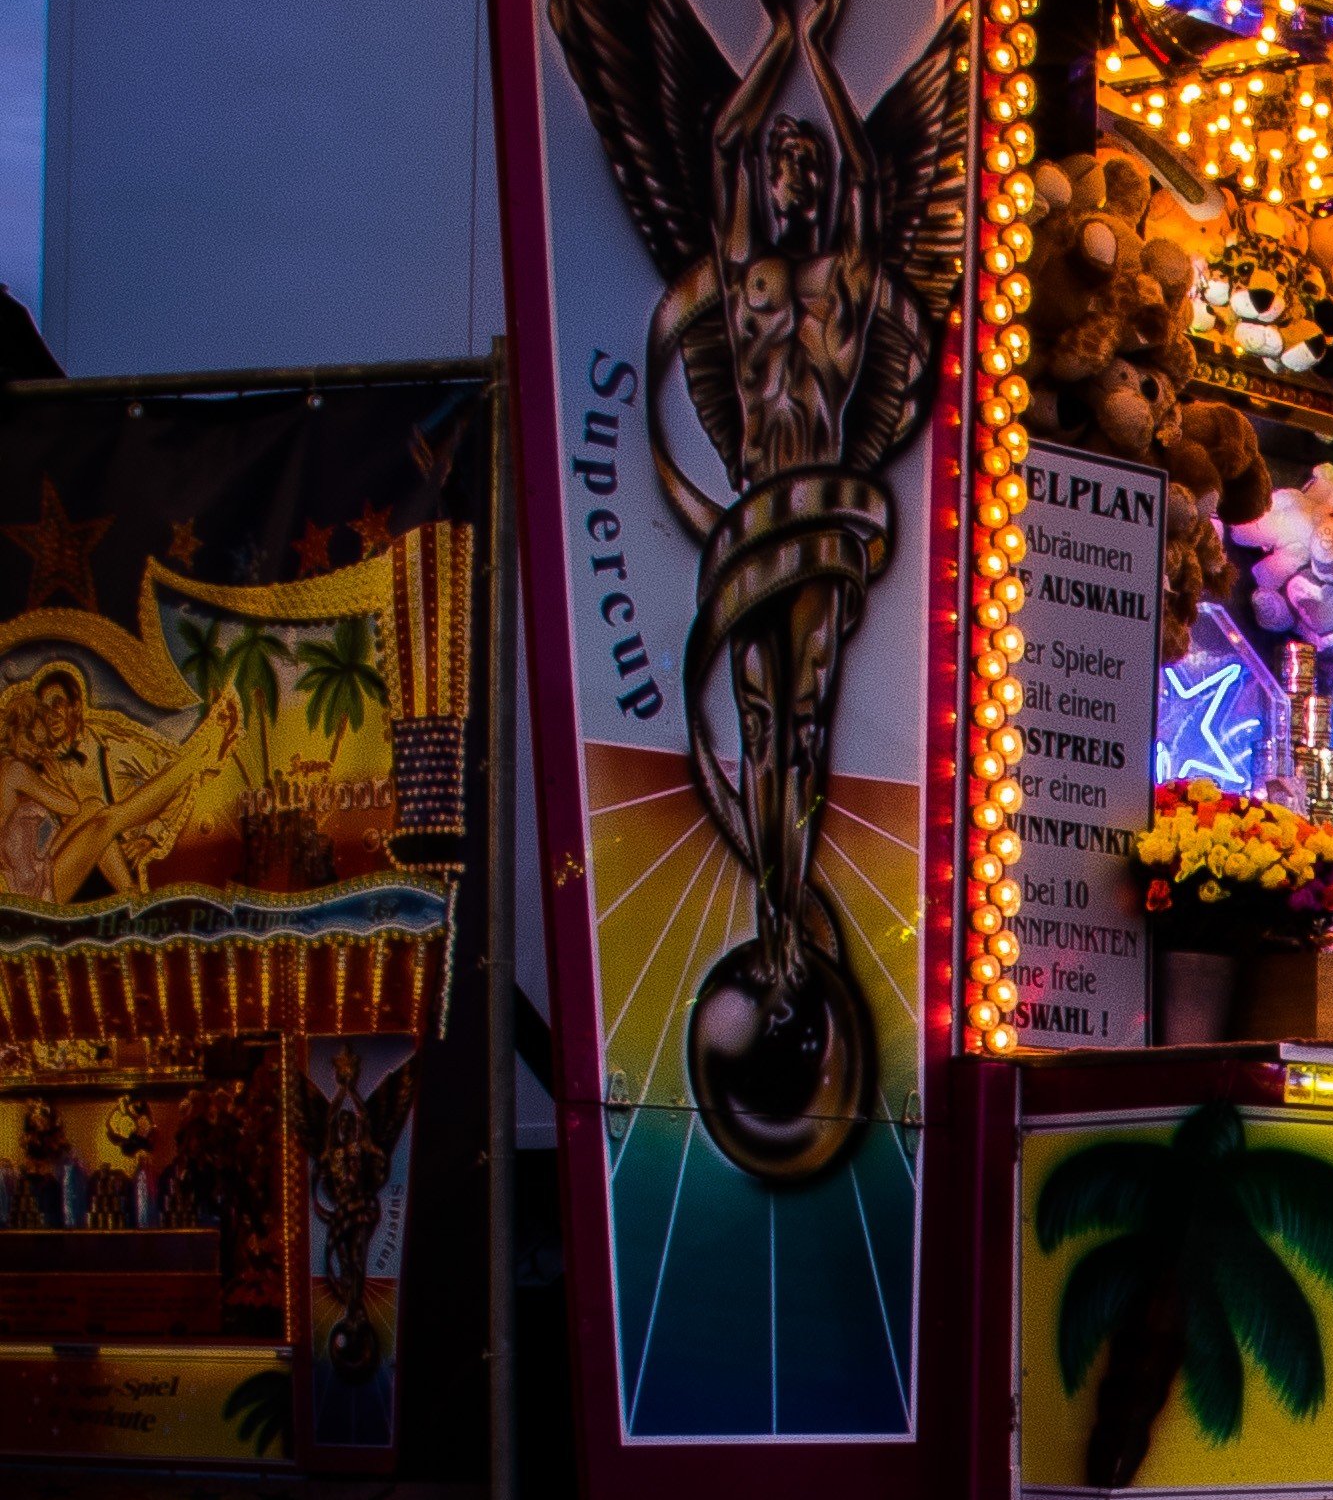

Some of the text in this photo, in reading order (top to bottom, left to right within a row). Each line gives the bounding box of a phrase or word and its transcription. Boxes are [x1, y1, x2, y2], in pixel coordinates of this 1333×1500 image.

[1015, 464, 1157, 529] ELPLAN
[587, 346, 667, 723] Supercup
[1038, 574, 1151, 622] AUSWAHL
[1051, 640, 1126, 682] Spieler
[1058, 690, 1117, 724] einen
[237, 775, 397, 816] HOLLYWOOD
[1049, 774, 1108, 809] einen
[1023, 874, 1091, 910] bei 10
[97, 907, 300, 938] Happy Playtime
[1050, 961, 1099, 995] freie
